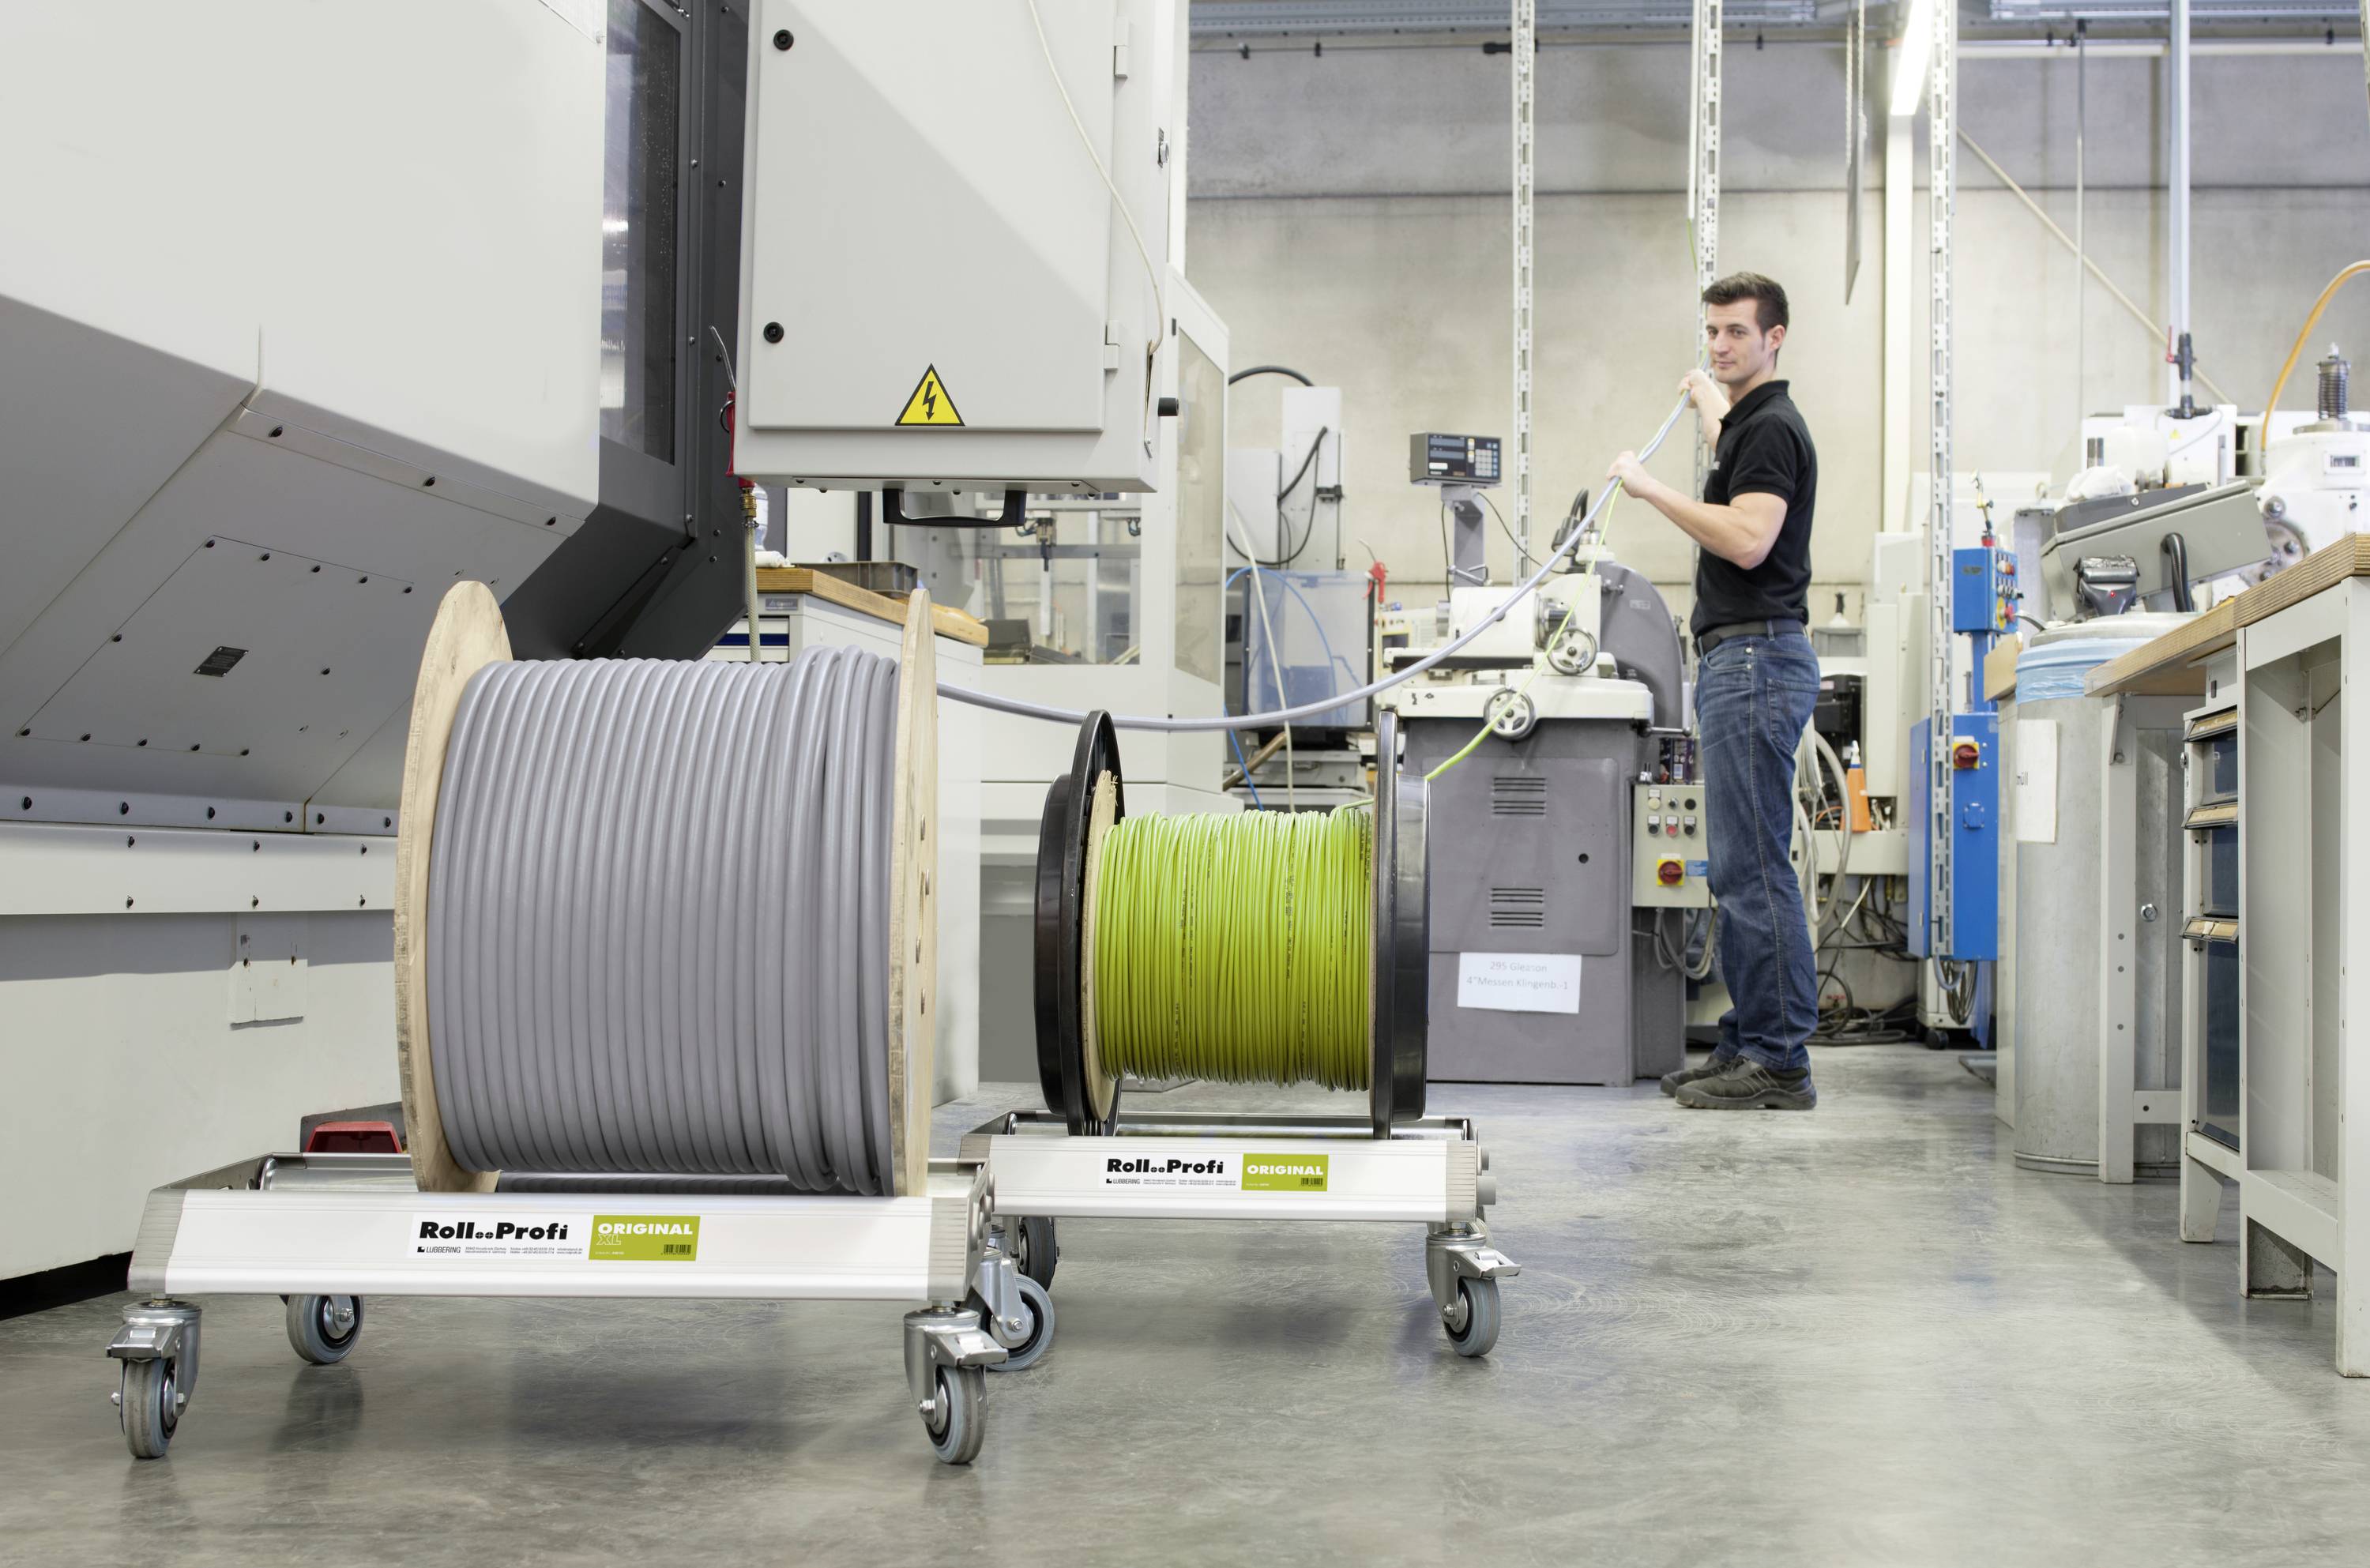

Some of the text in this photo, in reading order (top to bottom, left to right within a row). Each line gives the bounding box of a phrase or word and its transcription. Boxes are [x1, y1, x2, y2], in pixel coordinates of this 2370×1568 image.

[1489, 961, 1548, 972] 295 Gleason
[1247, 1164, 1324, 1175] ORIGINAL
[598, 1223, 693, 1235] ORIGINAL
[596, 1234, 622, 1246] XL
